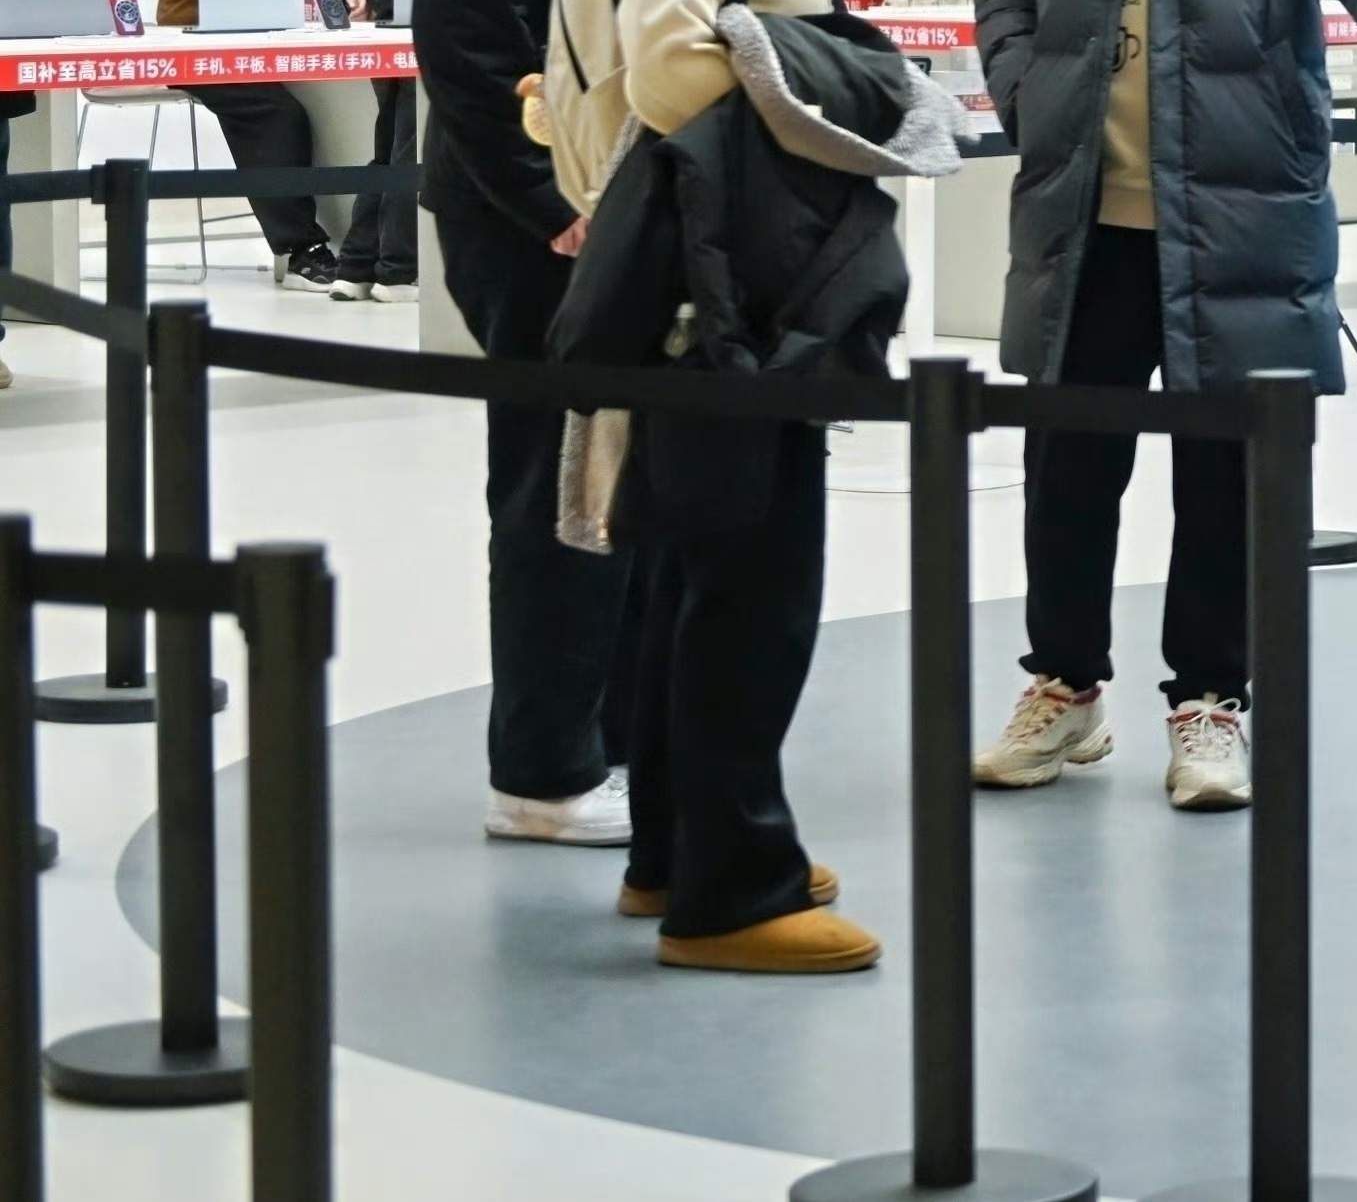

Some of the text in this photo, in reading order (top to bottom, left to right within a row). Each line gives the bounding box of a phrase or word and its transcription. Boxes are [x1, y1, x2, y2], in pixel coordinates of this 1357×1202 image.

[18, 58, 177, 85] 国补至高立省15%
